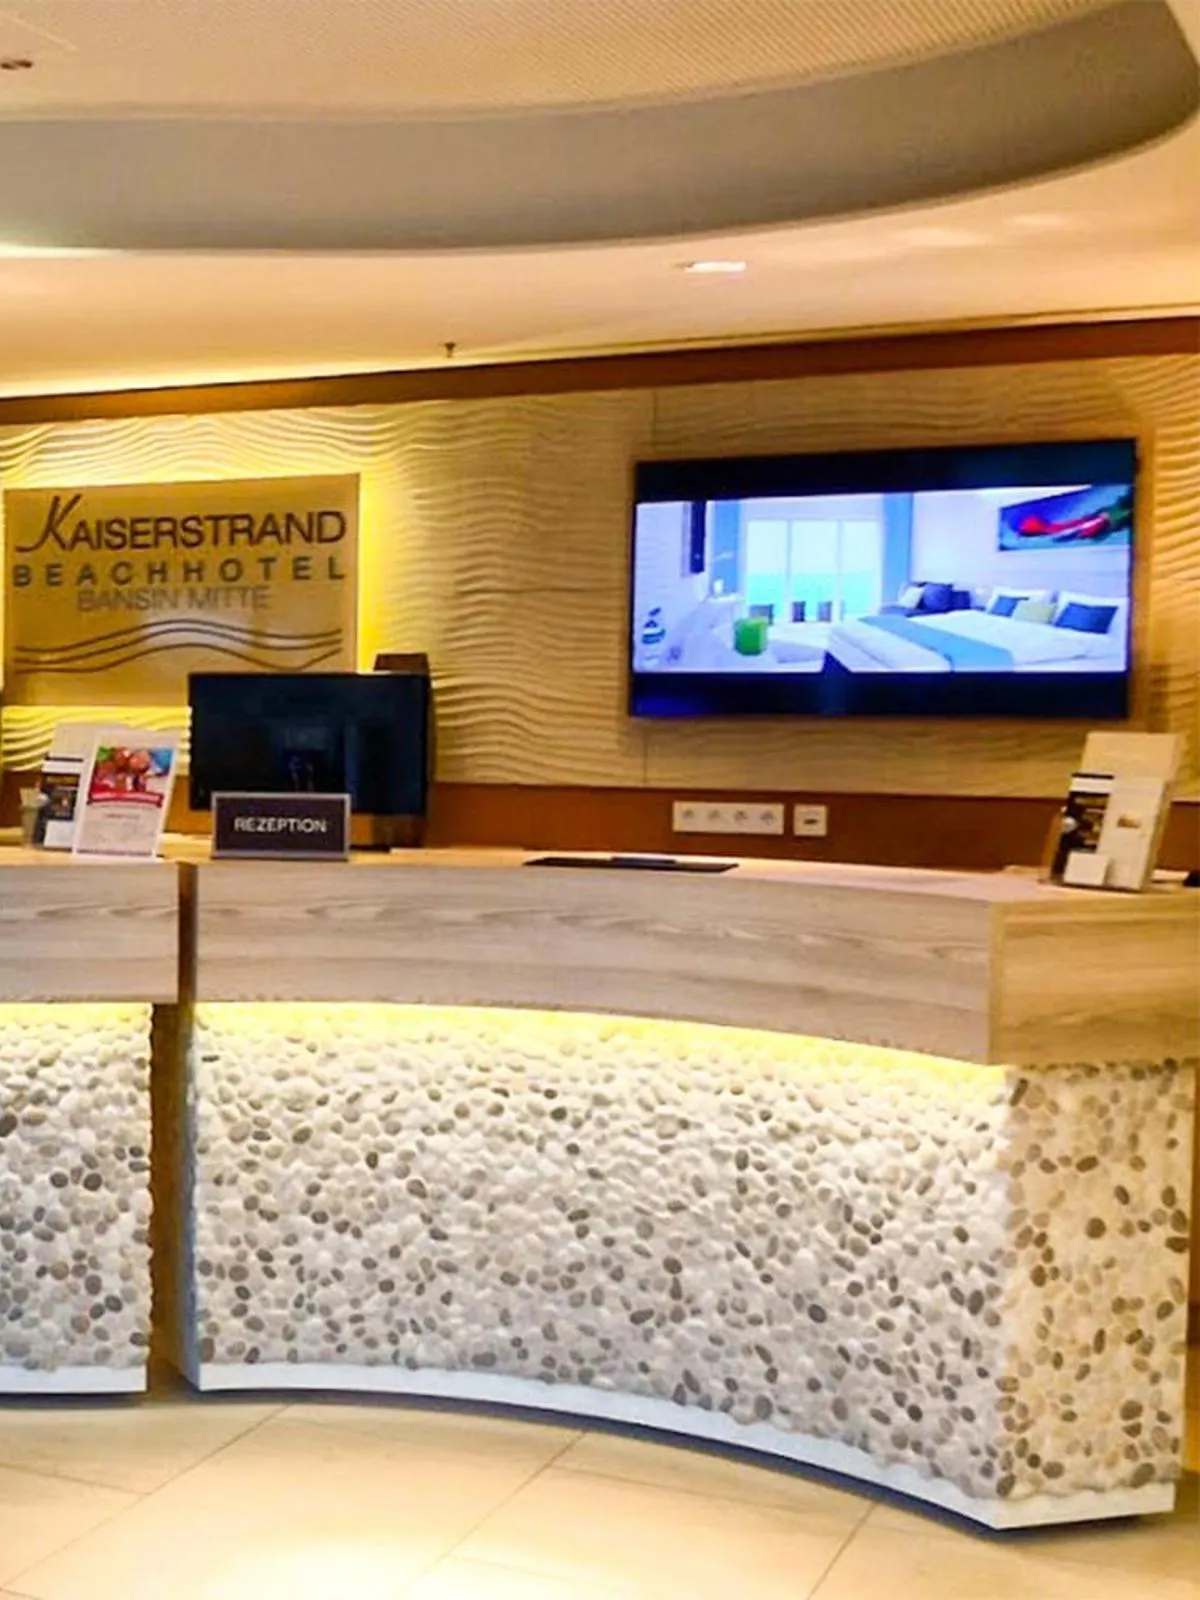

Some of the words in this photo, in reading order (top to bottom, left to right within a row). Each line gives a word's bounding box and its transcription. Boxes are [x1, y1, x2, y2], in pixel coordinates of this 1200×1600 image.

[15, 494, 346, 552] KAISERSTRAND
[12, 556, 345, 587] BEACHHOTEL
[78, 586, 176, 613] BANSIN
[188, 585, 273, 609] MITTE
[234, 816, 327, 833] REZEPTION
